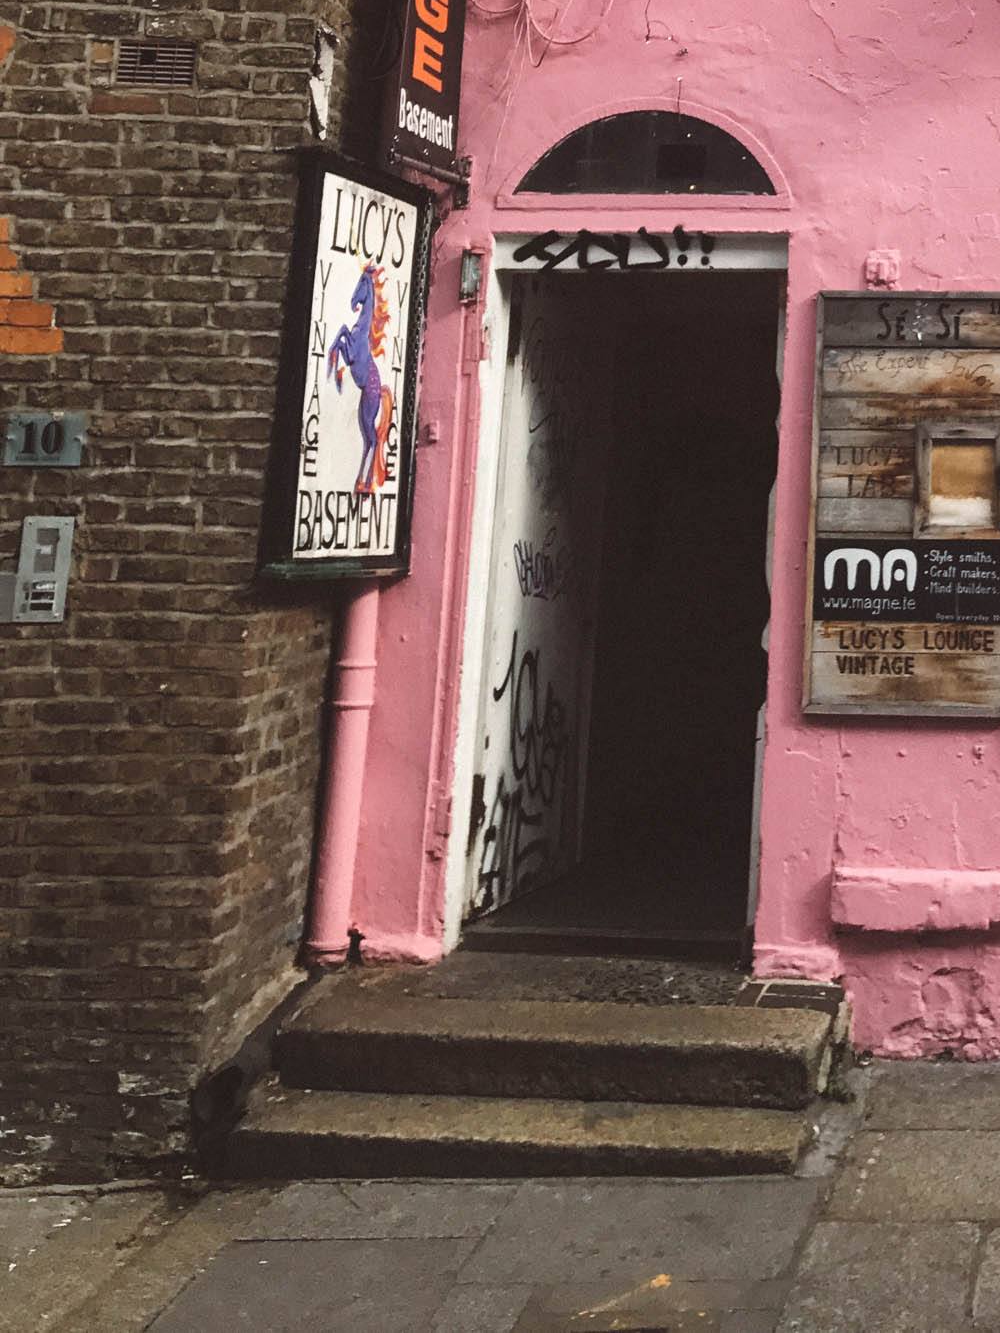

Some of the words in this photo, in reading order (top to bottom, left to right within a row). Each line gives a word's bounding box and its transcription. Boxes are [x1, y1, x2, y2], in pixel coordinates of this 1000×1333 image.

[399, 87, 453, 151] Basement
[330, 187, 406, 269] LUCY'S
[303, 259, 333, 479] VINTAGE
[19, 420, 65, 455] 10
[295, 489, 396, 552] BASEMENT
[823, 597, 916, 614] www.magne.ie
[836, 655, 915, 675] VINTAGE
[838, 629, 905, 650] LUCY'S
[924, 630, 995, 652] LOUNGE
